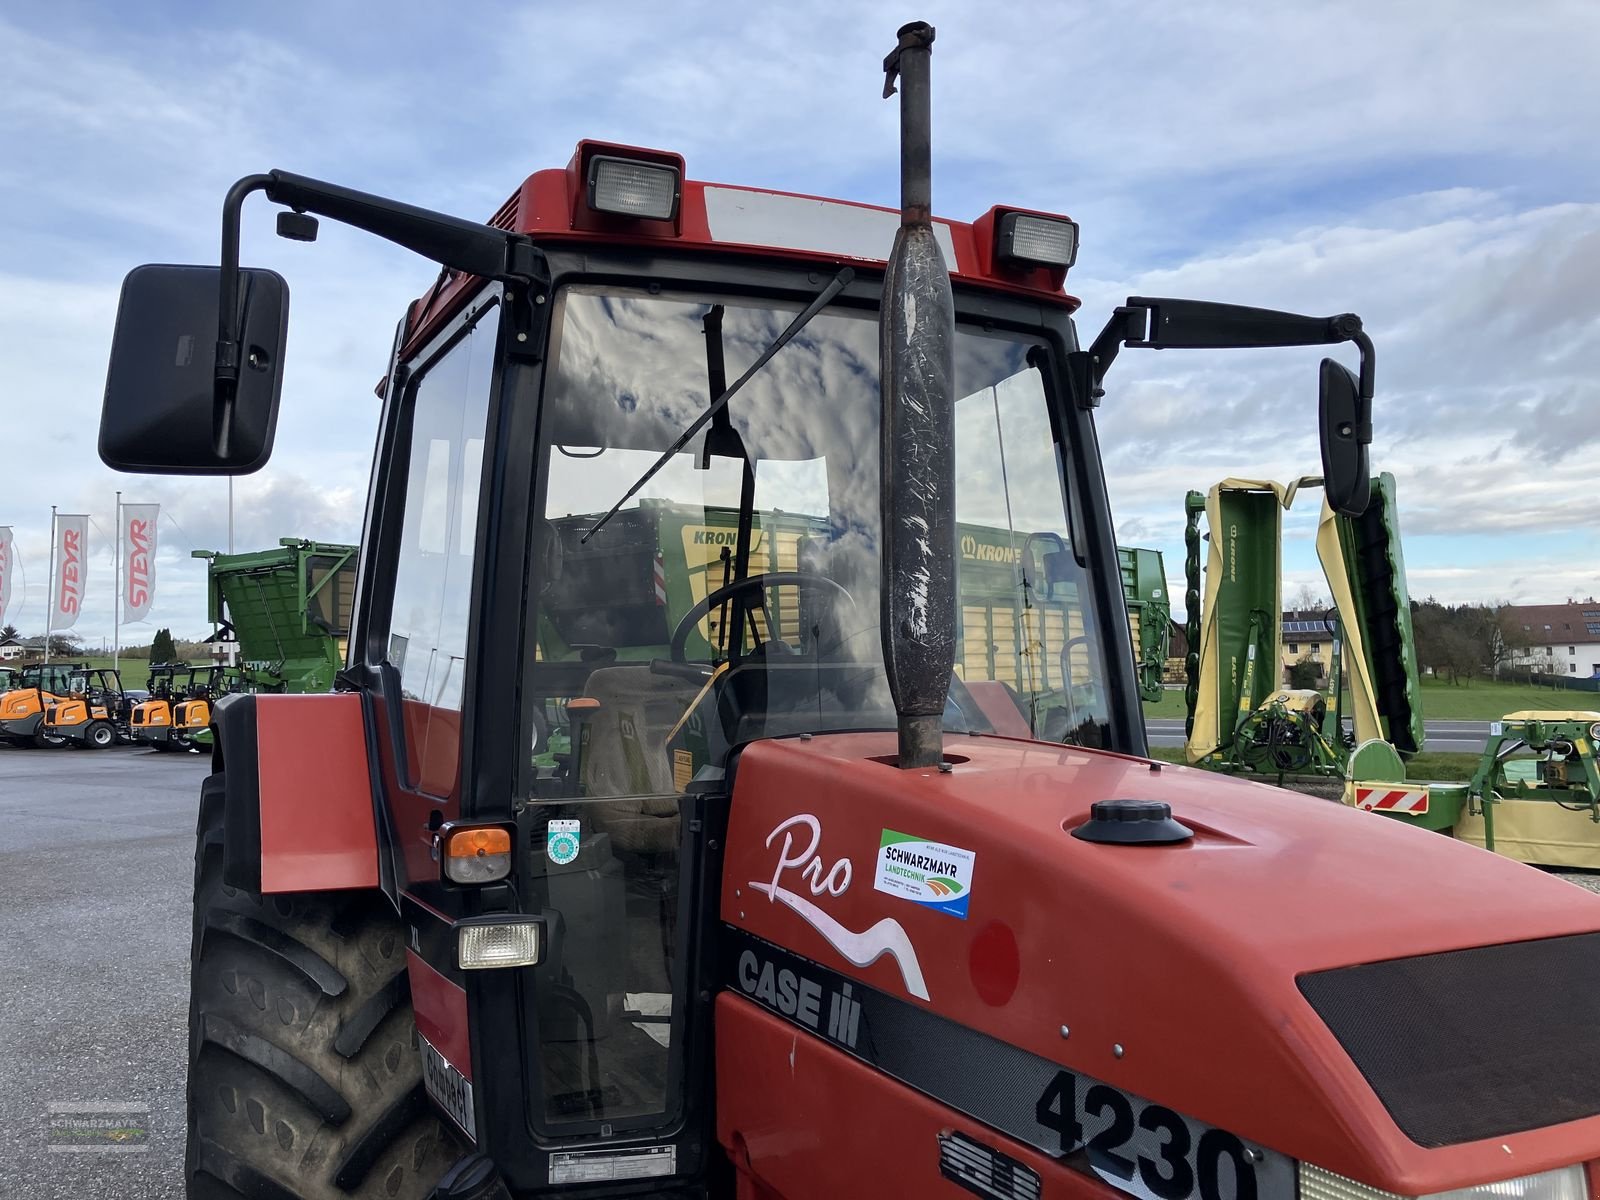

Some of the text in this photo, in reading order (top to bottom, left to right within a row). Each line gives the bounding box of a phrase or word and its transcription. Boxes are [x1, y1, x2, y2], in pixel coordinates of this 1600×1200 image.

[129, 518, 149, 608] STEYR
[694, 531, 737, 546] KRON
[976, 543, 1022, 564] KRONE
[60, 528, 80, 615] STEYR
[1328, 678, 1336, 695] EASY
[765, 813, 852, 903] Pro
[885, 846, 958, 878] SCHWARZMAYR
[885, 863, 926, 883] LANDTECHNIK
[738, 949, 822, 1029] CASE
[1035, 1070, 1258, 1200] 4230
